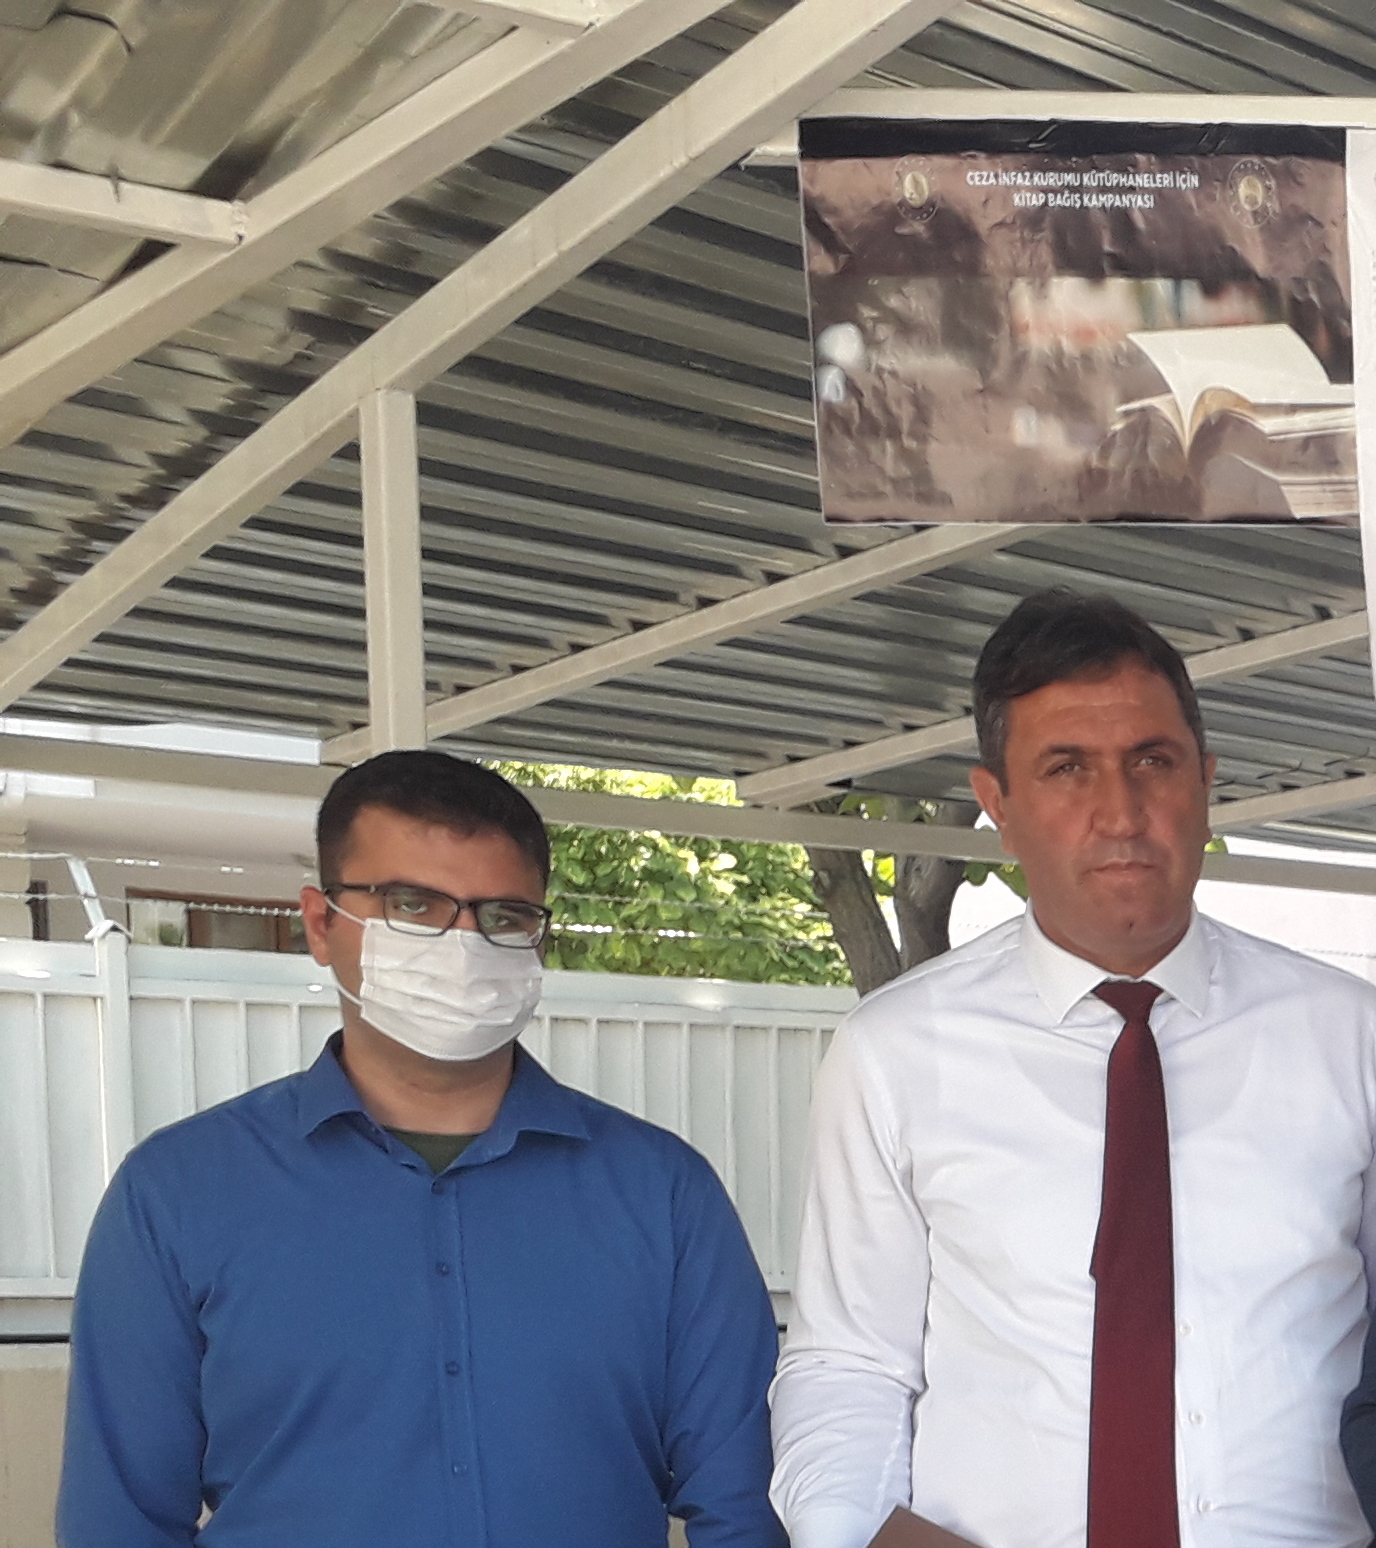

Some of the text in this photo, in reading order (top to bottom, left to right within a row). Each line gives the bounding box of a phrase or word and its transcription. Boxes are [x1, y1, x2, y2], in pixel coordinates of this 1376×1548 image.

[966, 169, 1199, 191] CEZA İNFAZ KURUMU KÜTÜPHANELERİ İÇİN
[1012, 190, 1155, 211] KİTAP BAĞIŞ KAMPANYASI
